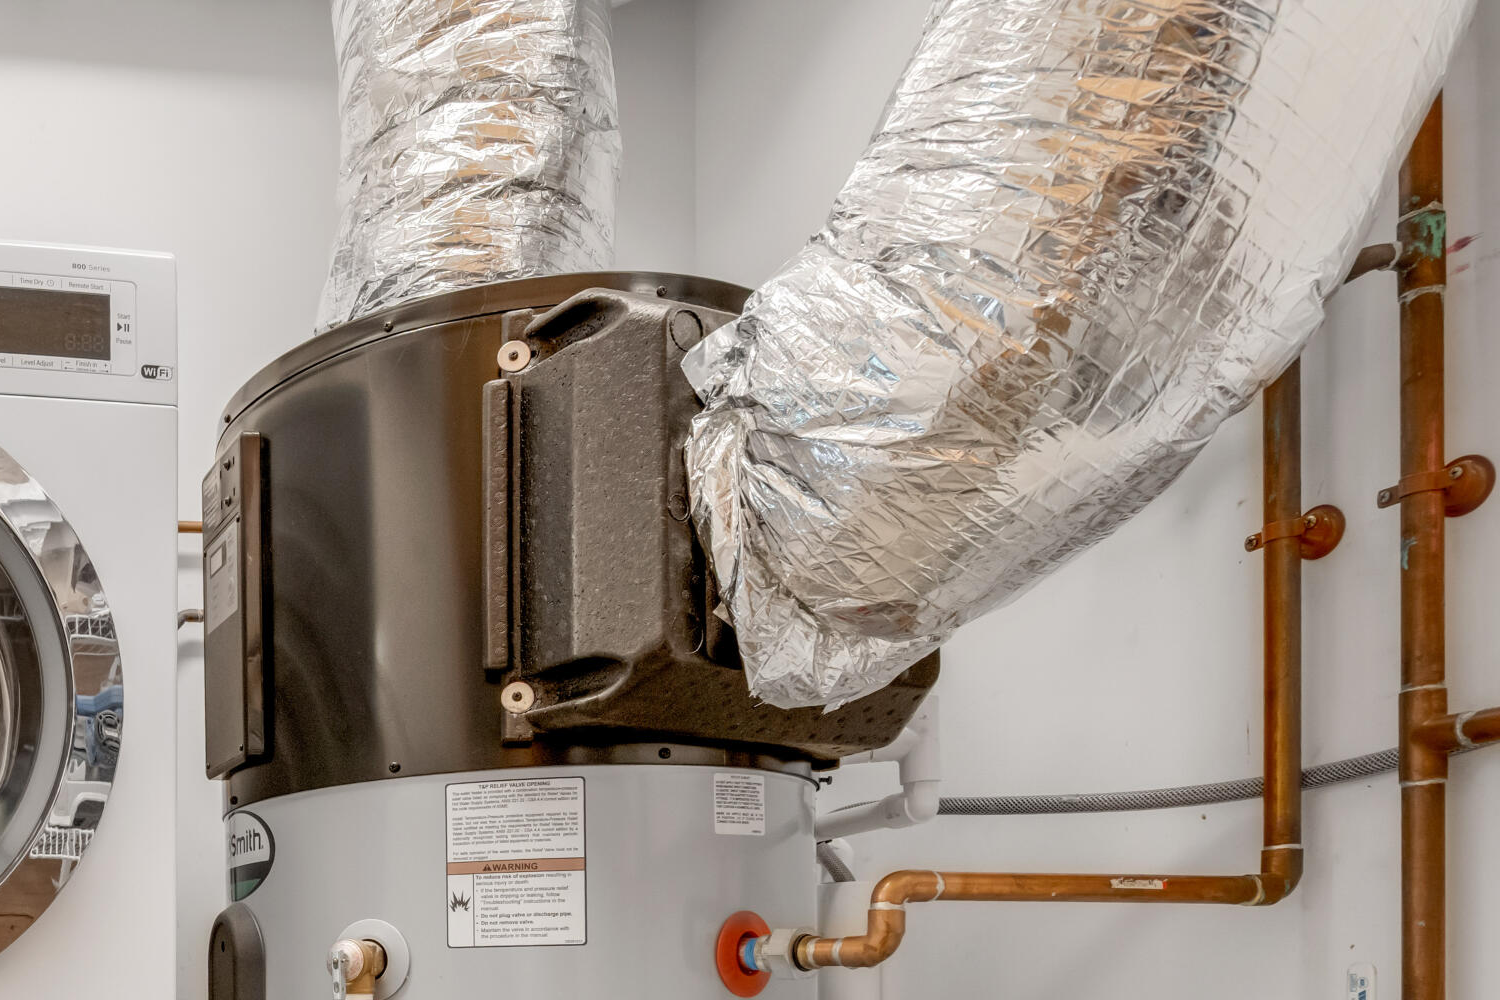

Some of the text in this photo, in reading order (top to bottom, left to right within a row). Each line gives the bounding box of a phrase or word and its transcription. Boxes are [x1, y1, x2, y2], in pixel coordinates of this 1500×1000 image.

[37, 360, 54, 368] Adjust
[76, 360, 91, 368] Finish
[230, 828, 263, 857] Smith
[492, 862, 538, 871] WARNING
